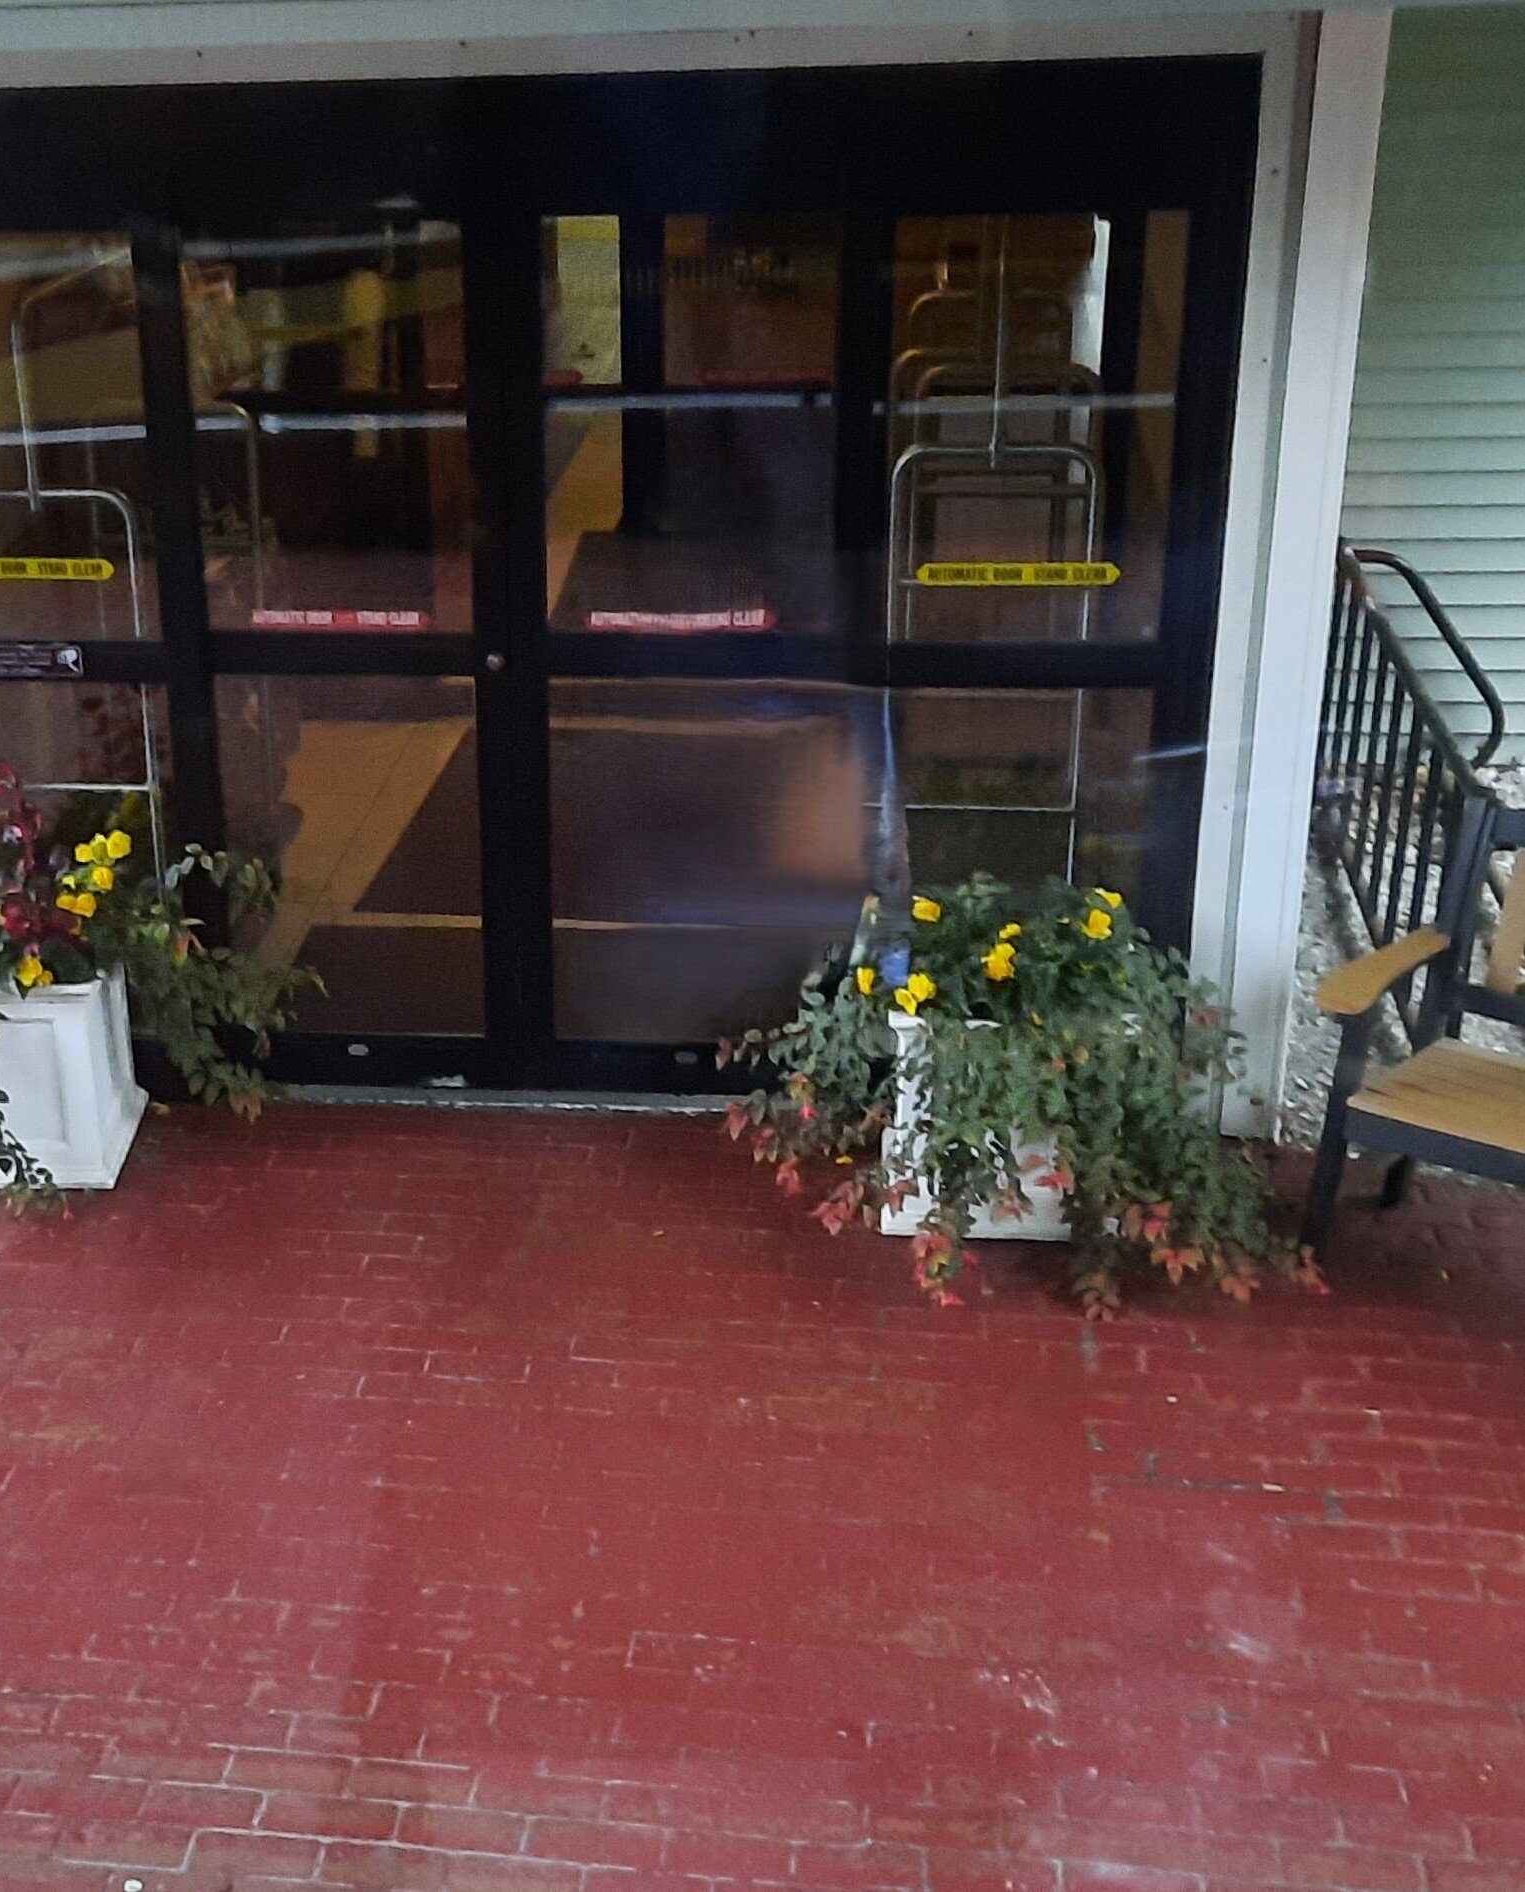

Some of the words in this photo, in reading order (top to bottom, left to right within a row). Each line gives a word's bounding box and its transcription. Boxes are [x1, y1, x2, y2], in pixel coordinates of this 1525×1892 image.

[0, 562, 28, 575] DOOR
[36, 562, 67, 575] STAND
[72, 563, 104, 576] CLEAR
[927, 567, 989, 581] AUTOMATIC
[993, 567, 1024, 581] DOOR
[1033, 567, 1068, 581] STAND
[1072, 567, 1108, 581] CLEAR
